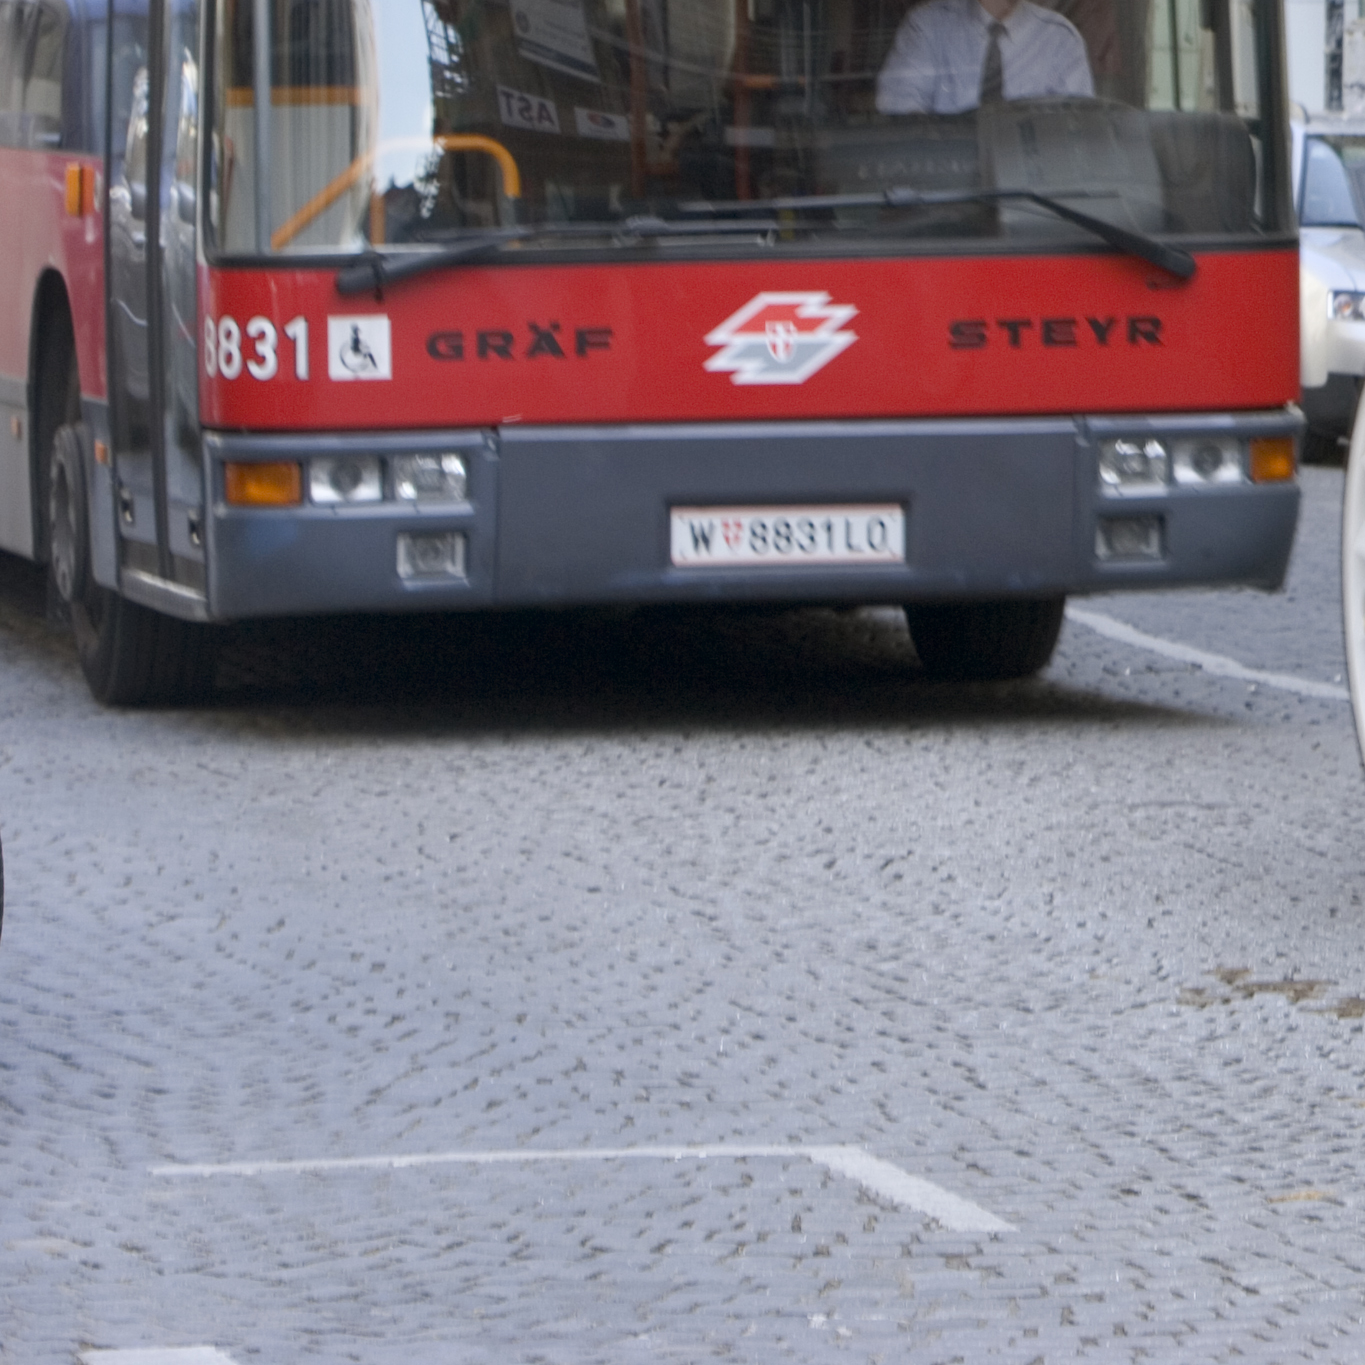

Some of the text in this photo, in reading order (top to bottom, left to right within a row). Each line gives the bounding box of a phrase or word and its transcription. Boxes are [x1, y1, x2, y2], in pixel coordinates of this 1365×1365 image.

[204, 314, 310, 381] 8831
[425, 320, 614, 363] GRÄF
[949, 316, 1166, 350] STEYR
